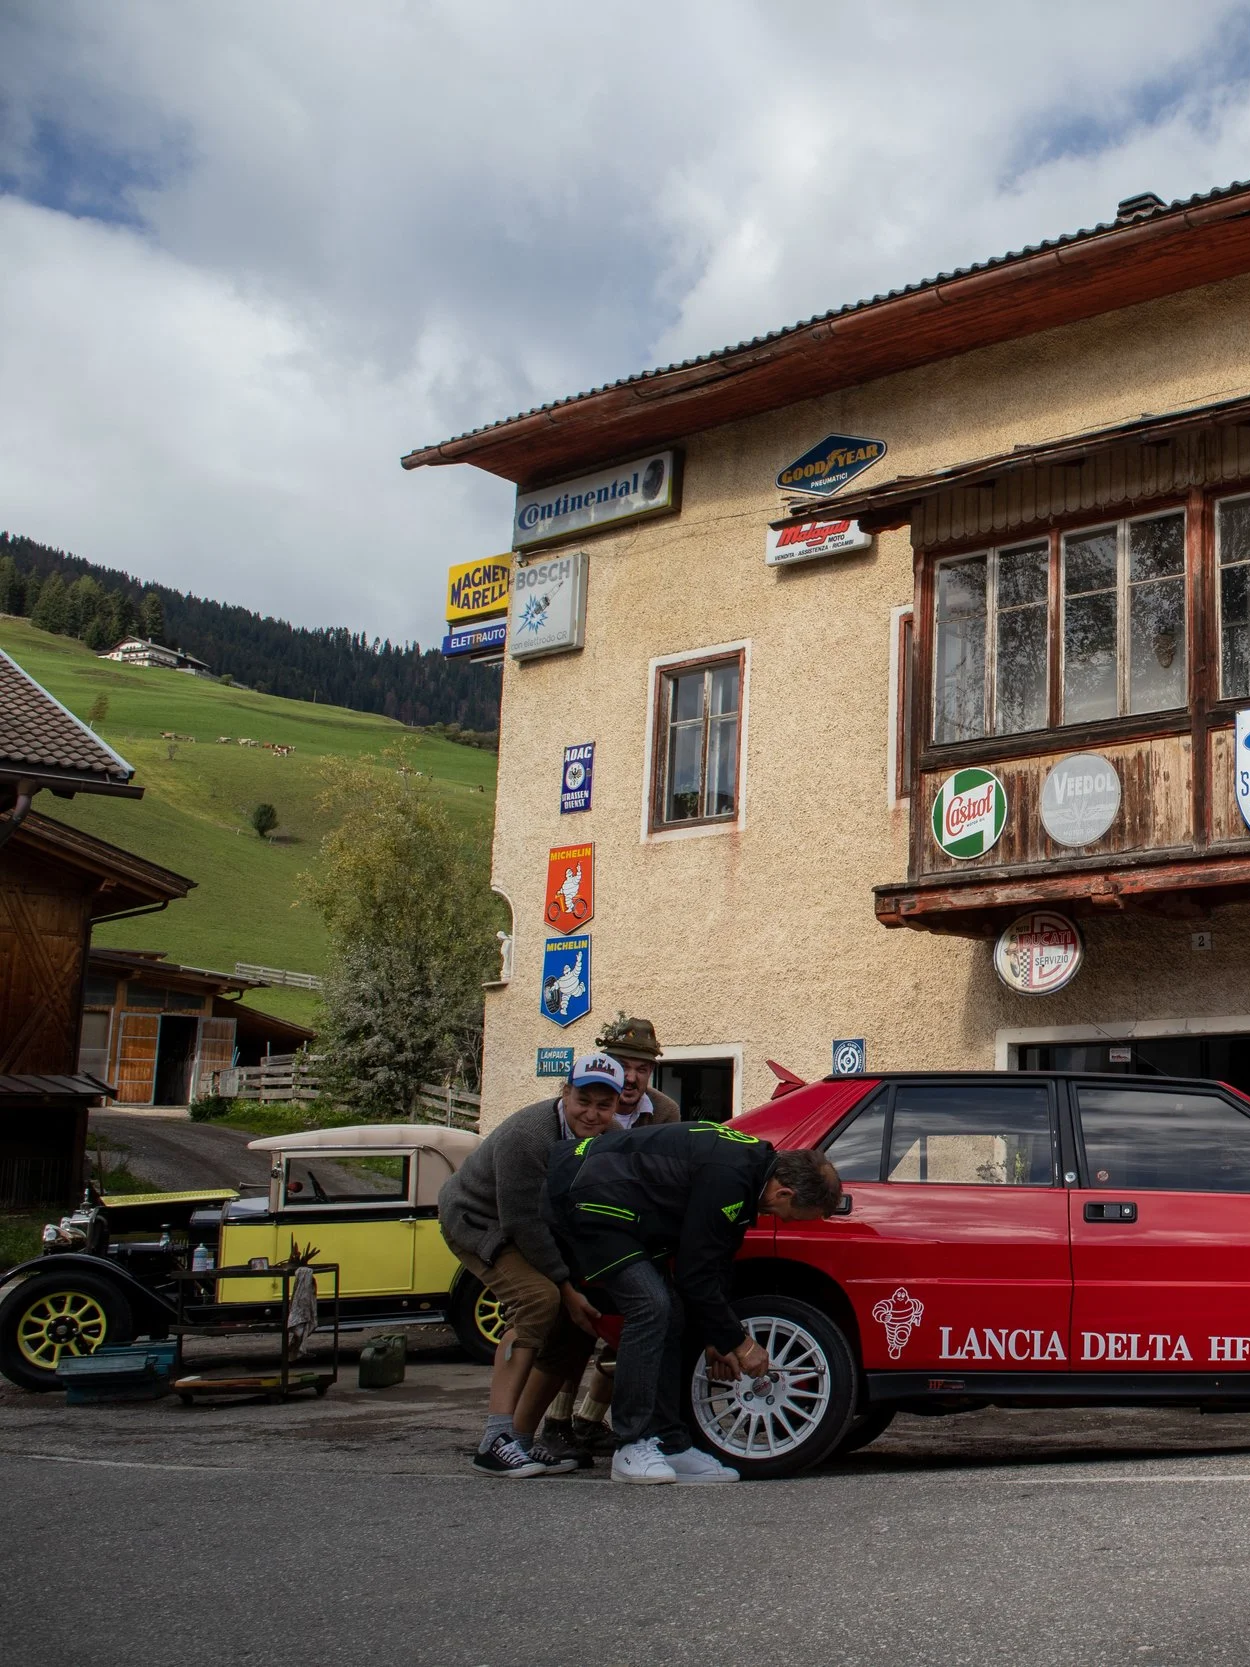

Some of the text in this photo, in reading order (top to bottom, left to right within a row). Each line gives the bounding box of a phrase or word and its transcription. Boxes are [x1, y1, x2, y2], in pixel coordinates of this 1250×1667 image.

[781, 444, 879, 484] GOODYEAR
[810, 472, 848, 488] PNEUMATICI
[517, 472, 639, 531] Continental
[827, 534, 846, 543] MOTO
[774, 539, 855, 561] VENDITA ASSISTENZA RICAMBI
[515, 559, 571, 591] BOSCH
[450, 628, 506, 649] ELETTRAUTO
[523, 633, 556, 649] elettrodo
[564, 746, 593, 763] ADAC
[1052, 772, 1116, 805] VEEDOL
[945, 784, 994, 837] Castrol
[550, 847, 592, 861] MICHELIN
[546, 939, 588, 952] MICHELIN
[1022, 931, 1072, 948] DUCATI
[1198, 935, 1205, 947] 2
[1034, 955, 1069, 967] SERVIZIO
[939, 1327, 1067, 1362] LANCIA
[1081, 1331, 1193, 1363] DELTA
